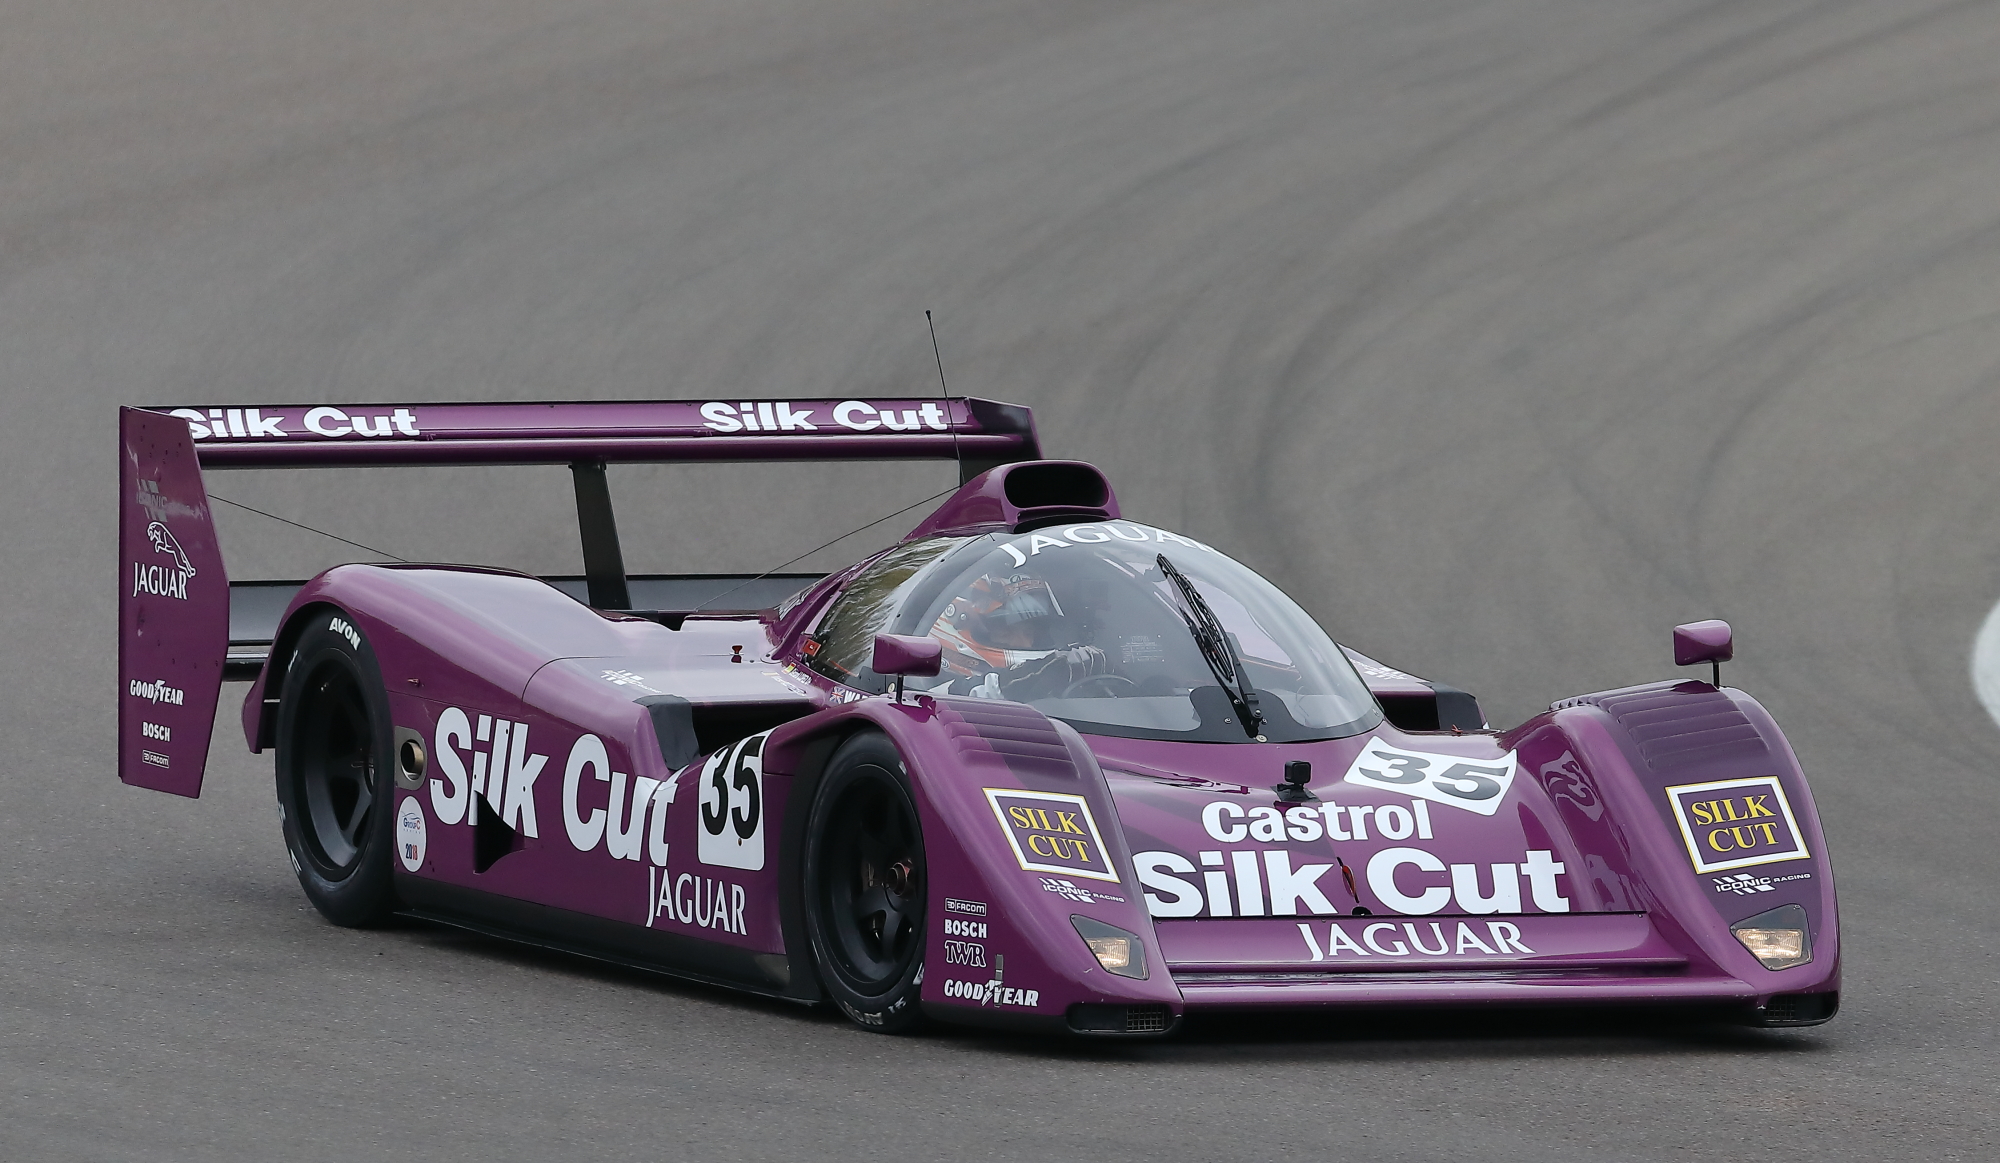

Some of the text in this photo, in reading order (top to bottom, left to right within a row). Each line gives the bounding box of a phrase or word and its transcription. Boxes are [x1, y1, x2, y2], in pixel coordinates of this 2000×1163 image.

[169, 406, 421, 439] Silk Cut
[699, 400, 948, 433] Silk Cut
[132, 561, 188, 600] JAGUAR
[328, 617, 361, 651] AVON
[129, 679, 184, 706] GOODYEAR
[142, 721, 171, 742] BOSCH
[430, 706, 690, 867] Silk Cut
[701, 735, 766, 840] 35
[1358, 750, 1509, 801] 35
[1008, 806, 1087, 836] SILK
[1201, 799, 1434, 843] Castrol
[1690, 794, 1777, 826] SILK
[1028, 834, 1092, 863] CUT
[1707, 822, 1780, 852] CUT
[1042, 884, 1092, 897] ICONIC
[1131, 846, 1571, 917] Silk Cut
[1716, 873, 1812, 892] ICONIC RACING
[646, 865, 748, 935] JAGUAR
[956, 902, 985, 914] FACOM
[944, 918, 987, 939] BOSCH
[1296, 921, 1536, 962] JAGUAR
[944, 939, 987, 968] TWR
[943, 978, 1040, 1007] GOODYEAR
